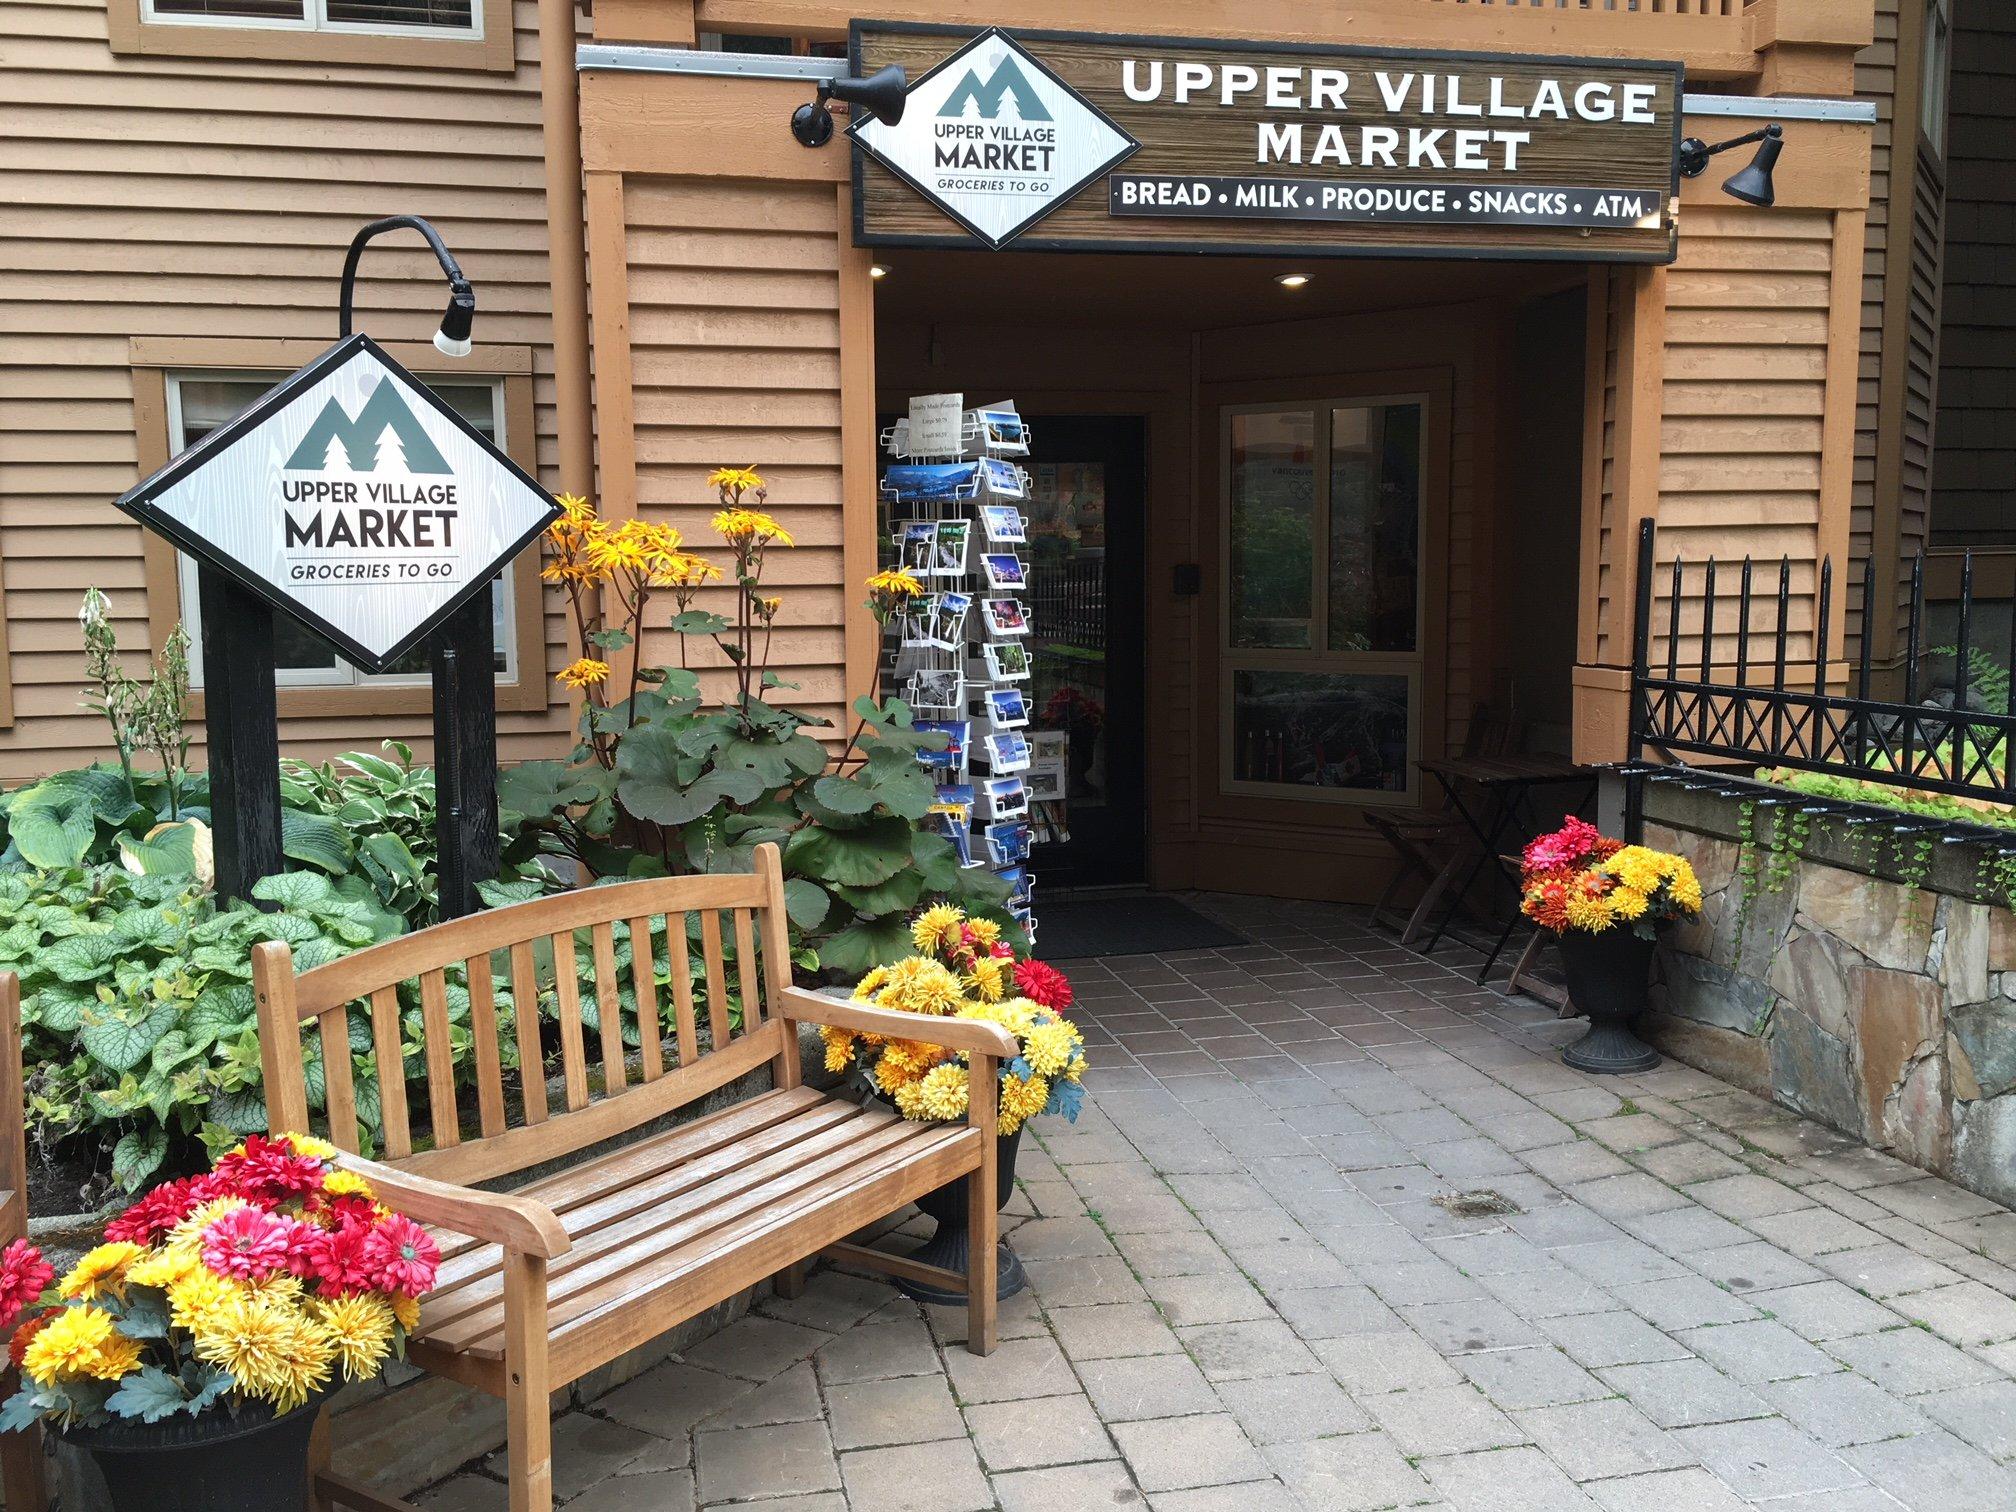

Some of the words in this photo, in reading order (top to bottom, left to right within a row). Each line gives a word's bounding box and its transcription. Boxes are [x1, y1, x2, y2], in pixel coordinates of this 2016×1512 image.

[1122, 60, 1349, 109] UPPER
[1374, 71, 1656, 124] VILLAGE
[934, 123, 984, 140] UPPER
[990, 126, 1055, 143] VILLAGE
[934, 142, 1055, 172] MARKET
[1257, 123, 1531, 171] MARKET
[937, 178, 1004, 191] GROCERIES
[1009, 181, 1026, 191] TO
[1030, 182, 1050, 192] GO
[1122, 181, 1212, 206] BREAD
[1235, 184, 1299, 209] MILK
[1322, 187, 1446, 212] PRODUCE
[1468, 192, 1568, 216] SNACKS
[1592, 196, 1643, 218] ATM
[1272, 466, 1313, 477] vancouve
[282, 480, 358, 503] UPPER
[365, 482, 457, 505] VILLAGE
[284, 508, 458, 548] MARKET
[290, 563, 391, 580] GROCERIES
[398, 563, 421, 578] TO
[426, 563, 453, 577] GO
